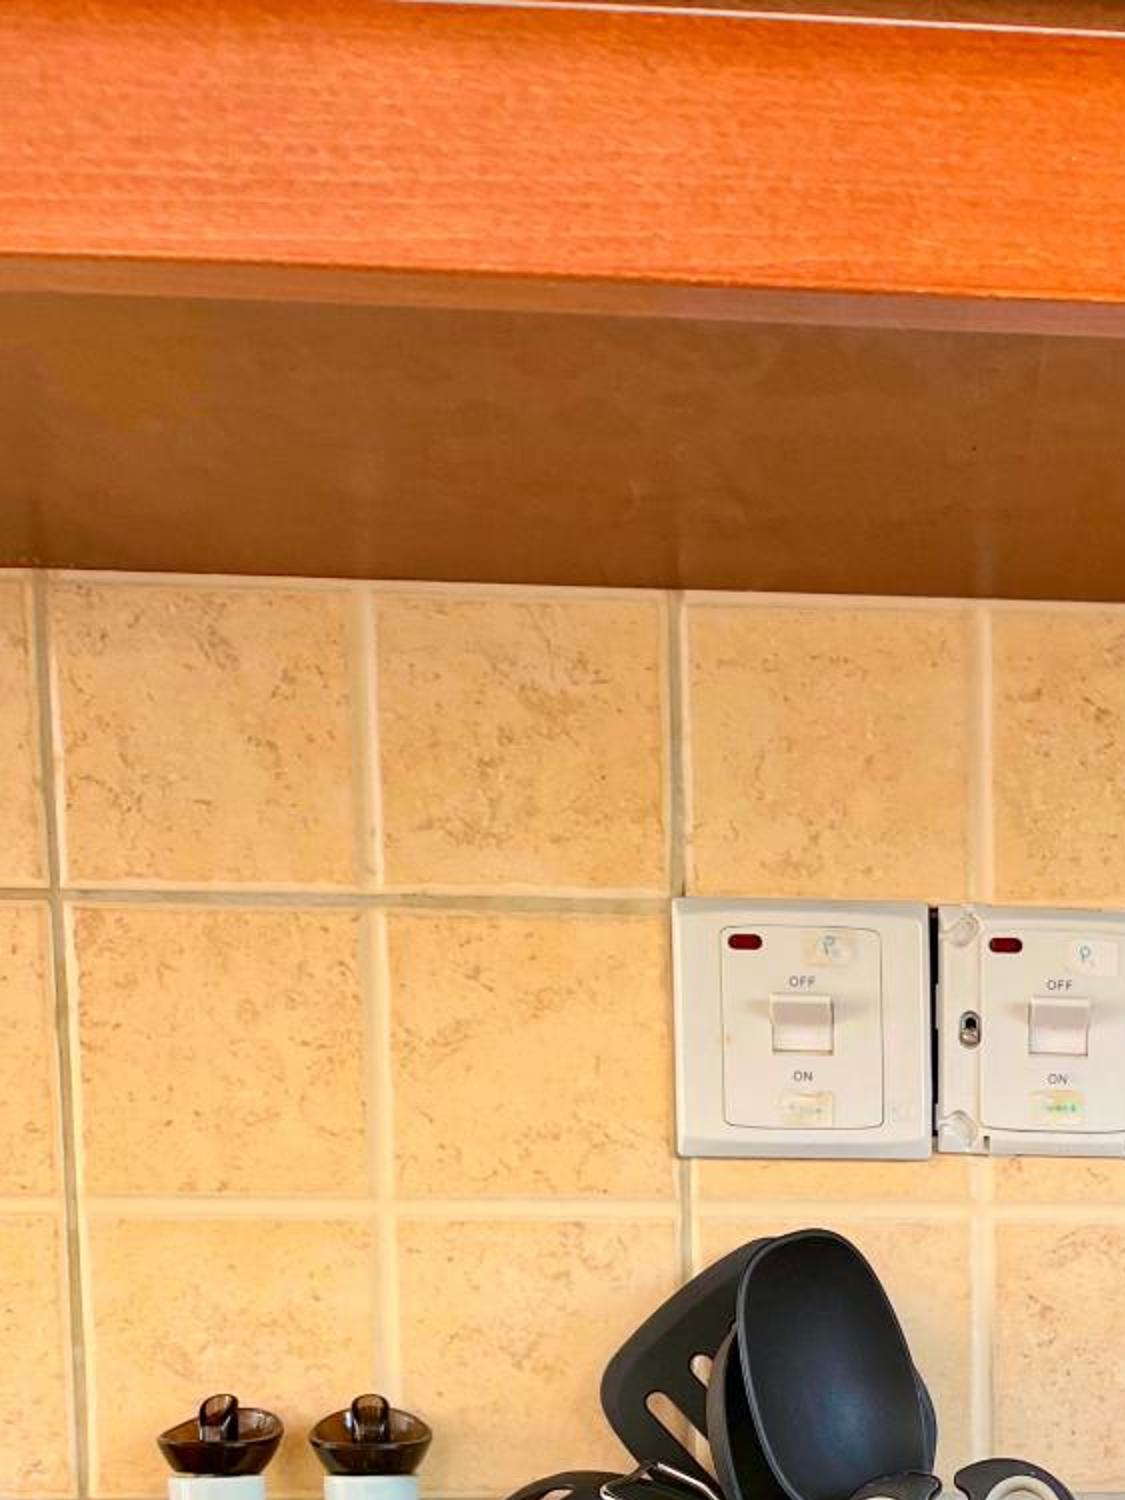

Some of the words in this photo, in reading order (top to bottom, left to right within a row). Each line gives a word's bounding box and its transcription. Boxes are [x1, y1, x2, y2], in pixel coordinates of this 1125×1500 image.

[788, 975, 816, 988] OFF
[1046, 979, 1073, 991] OFF
[793, 1070, 814, 1083] ON
[1047, 1073, 1069, 1086] ON
